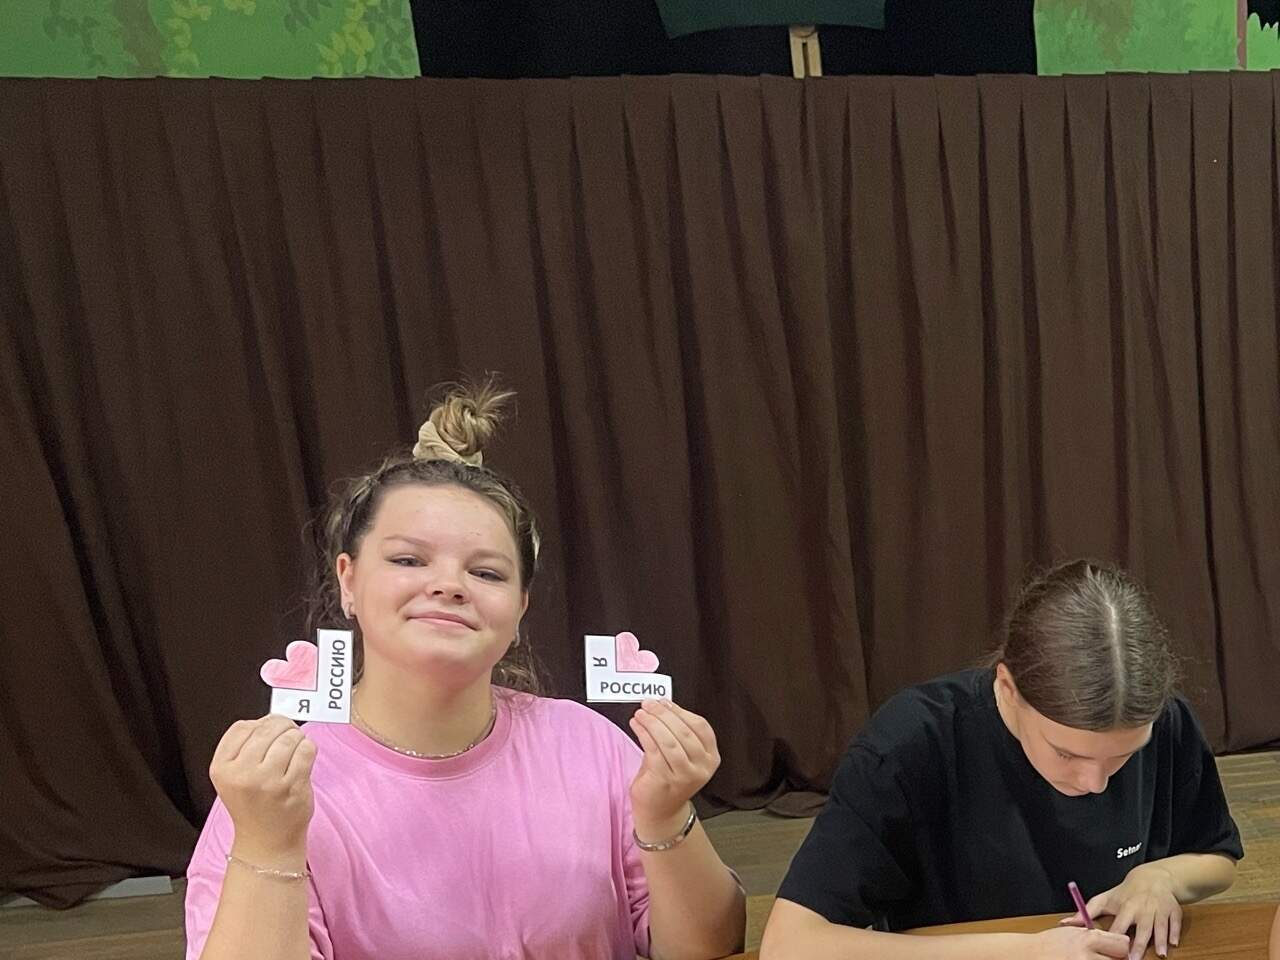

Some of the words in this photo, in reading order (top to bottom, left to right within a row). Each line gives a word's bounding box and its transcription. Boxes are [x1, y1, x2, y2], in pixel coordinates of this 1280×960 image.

[593, 656, 608, 667] Я
[328, 640, 346, 710] РОССИЮ
[600, 681, 666, 697] РОССИЮ
[298, 699, 311, 714] Я
